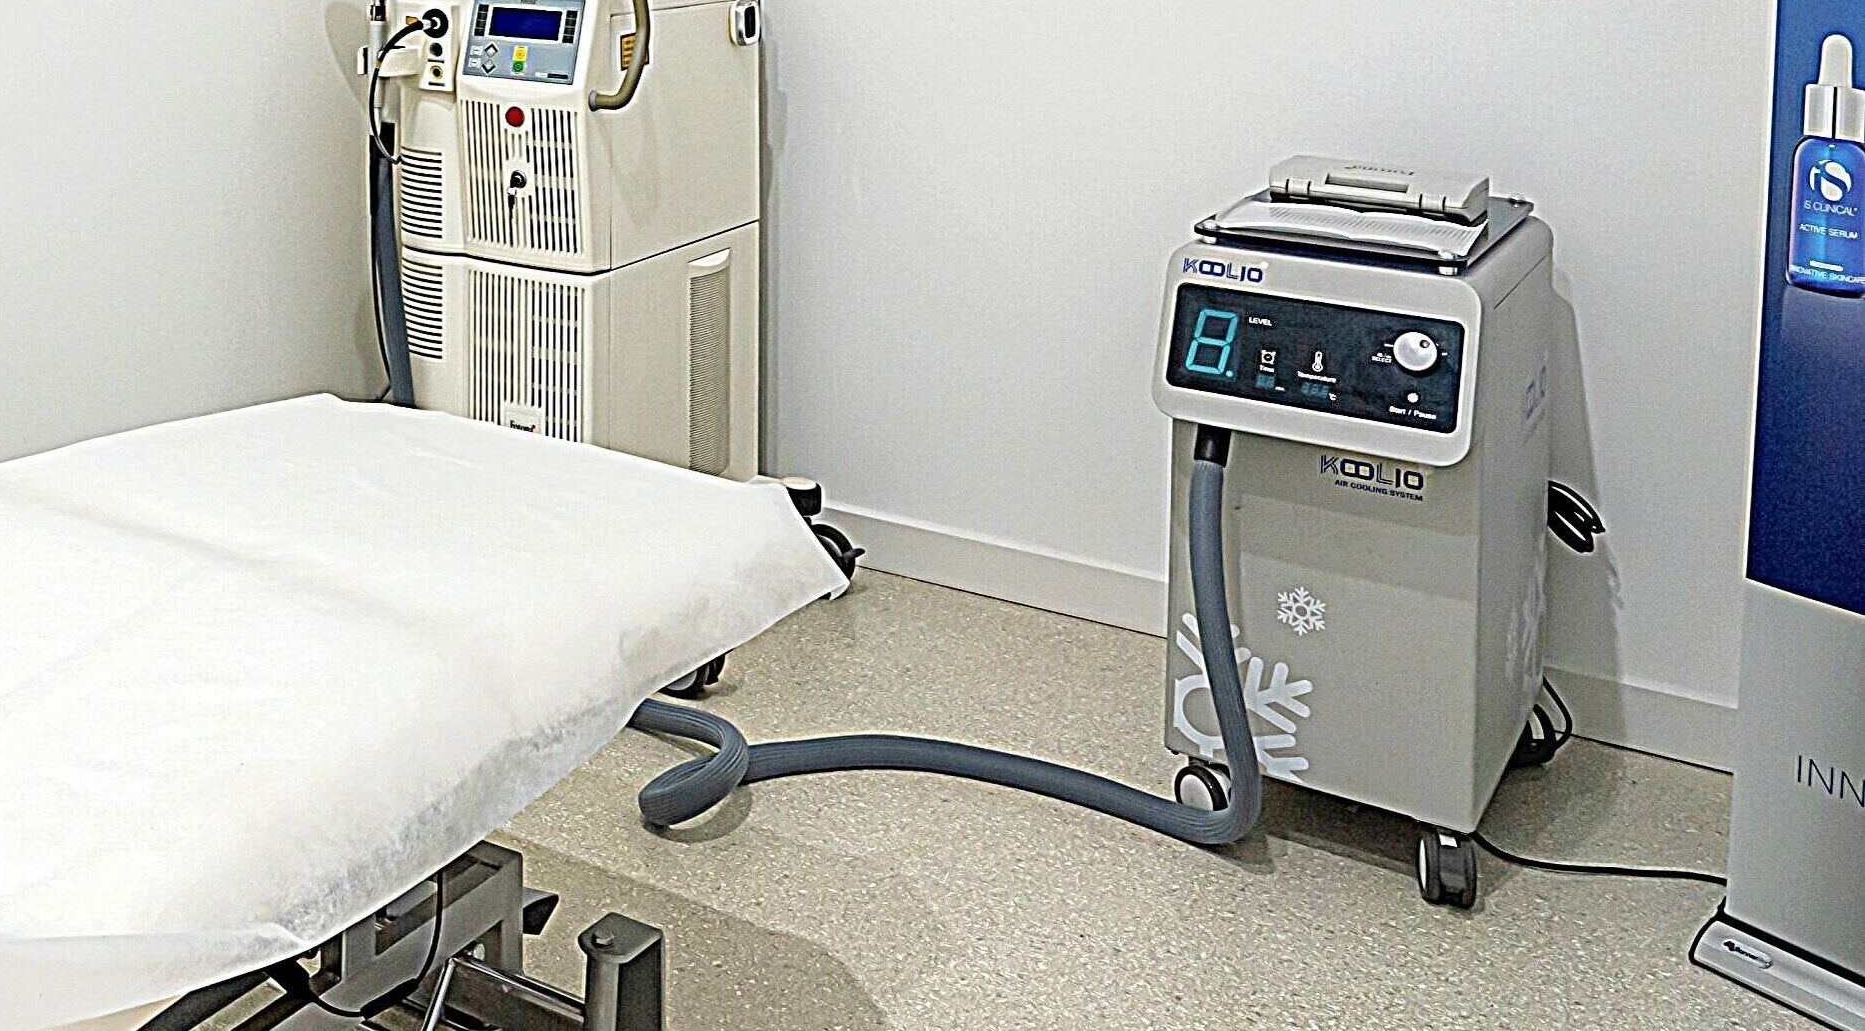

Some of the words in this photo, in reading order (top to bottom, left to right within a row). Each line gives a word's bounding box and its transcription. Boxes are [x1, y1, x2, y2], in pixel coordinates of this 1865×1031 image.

[1799, 223, 1826, 235] ACTIVE
[1828, 228, 1858, 239] SERUM
[1183, 257, 1263, 283] KOOLIO
[1248, 316, 1273, 327] LEVEL
[1320, 454, 1424, 491] KOOLIO
[1334, 479, 1349, 488] AIR
[1350, 482, 1388, 495] COOLING
[1389, 489, 1423, 502] SYSTEM
